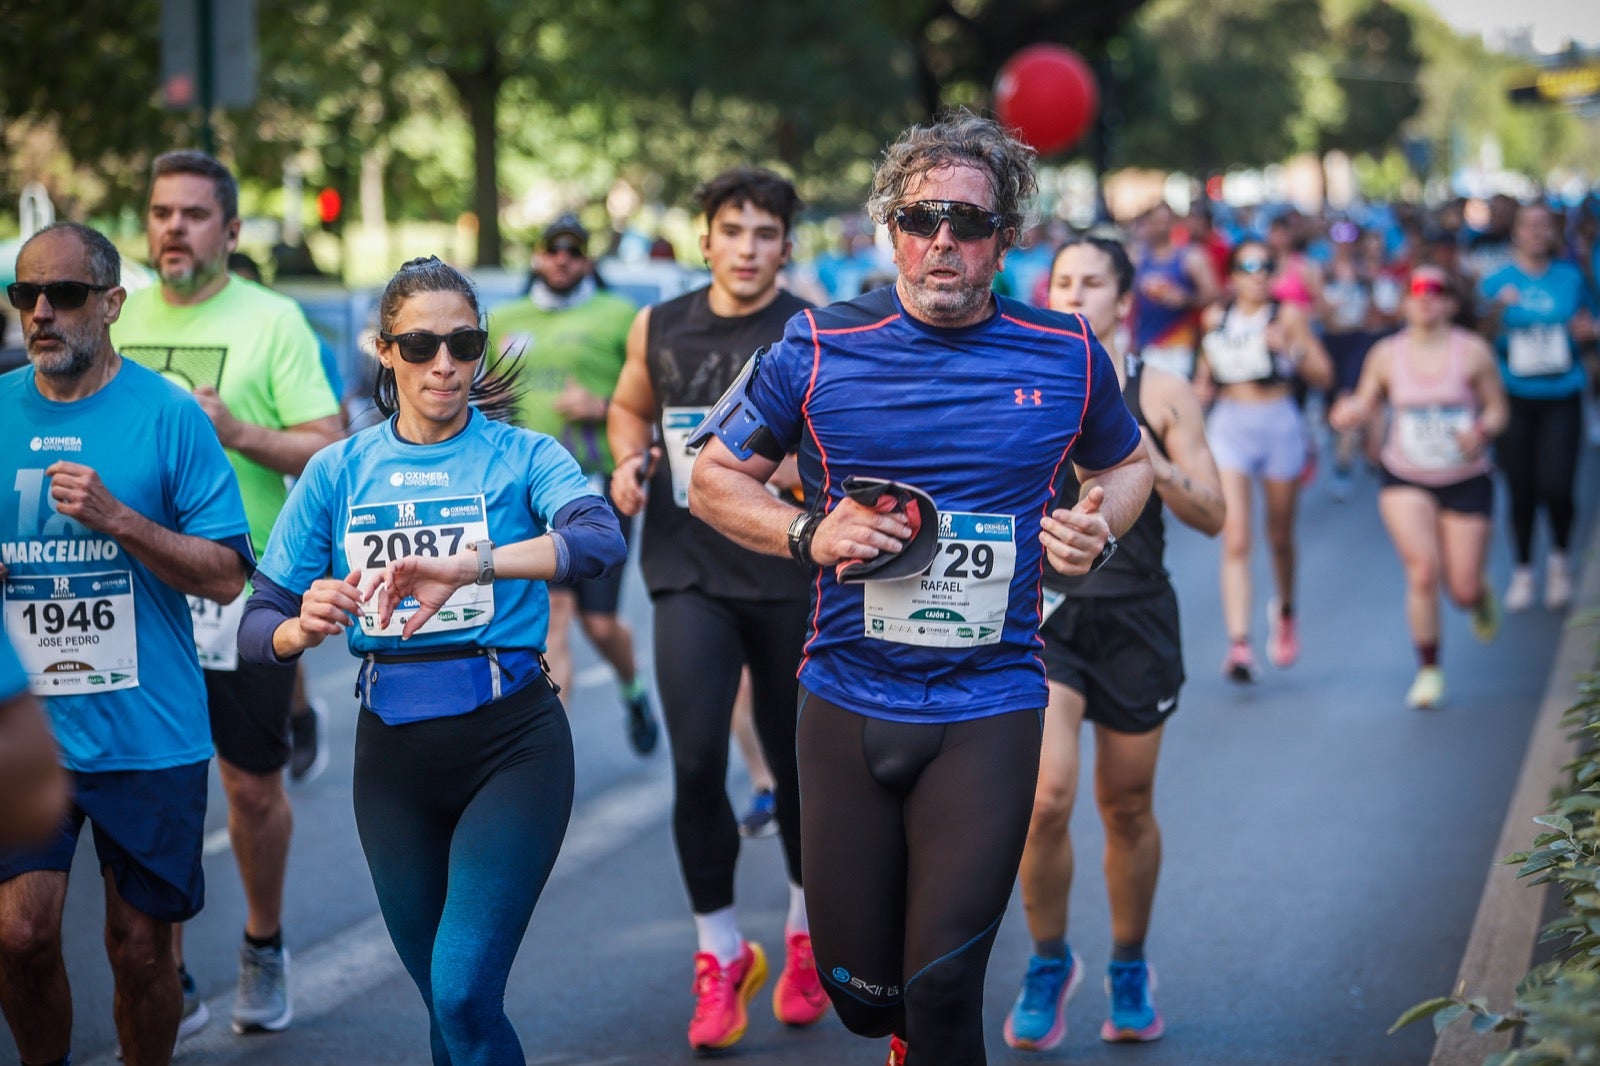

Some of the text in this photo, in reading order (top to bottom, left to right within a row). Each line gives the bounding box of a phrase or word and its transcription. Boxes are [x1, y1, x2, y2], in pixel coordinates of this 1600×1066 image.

[43, 436, 82, 446] OXIMESA
[404, 471, 449, 480] OXIMESA
[1, 540, 119, 565] MARCELINO
[363, 527, 465, 570] 2087
[920, 580, 963, 593] RAFAEL
[22, 598, 116, 635] 1946
[925, 610, 945, 619] CAJÓN
[38, 633, 100, 648] JOSE PEDRO
